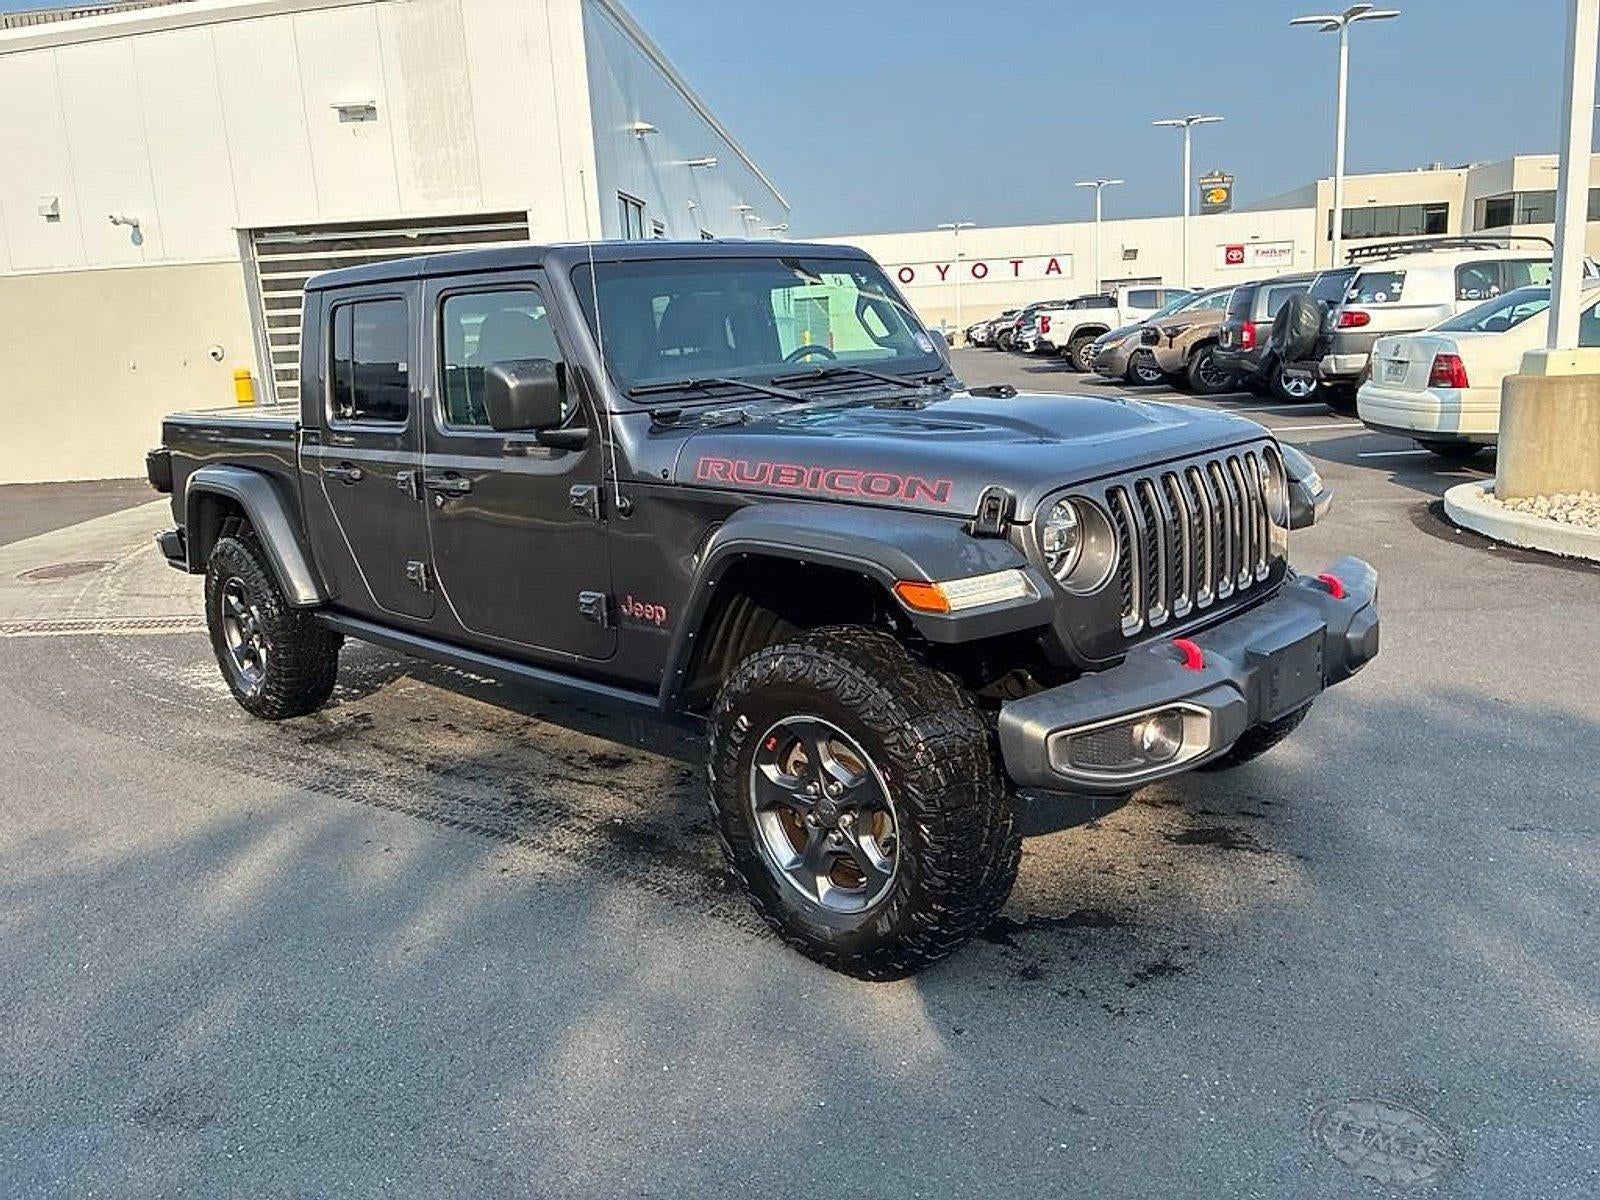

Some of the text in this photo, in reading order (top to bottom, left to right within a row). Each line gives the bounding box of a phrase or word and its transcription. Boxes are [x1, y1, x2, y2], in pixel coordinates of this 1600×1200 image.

[898, 258, 1062, 283] OYOTA
[697, 456, 953, 504] RUBICON
[620, 595, 667, 626] Jeep
